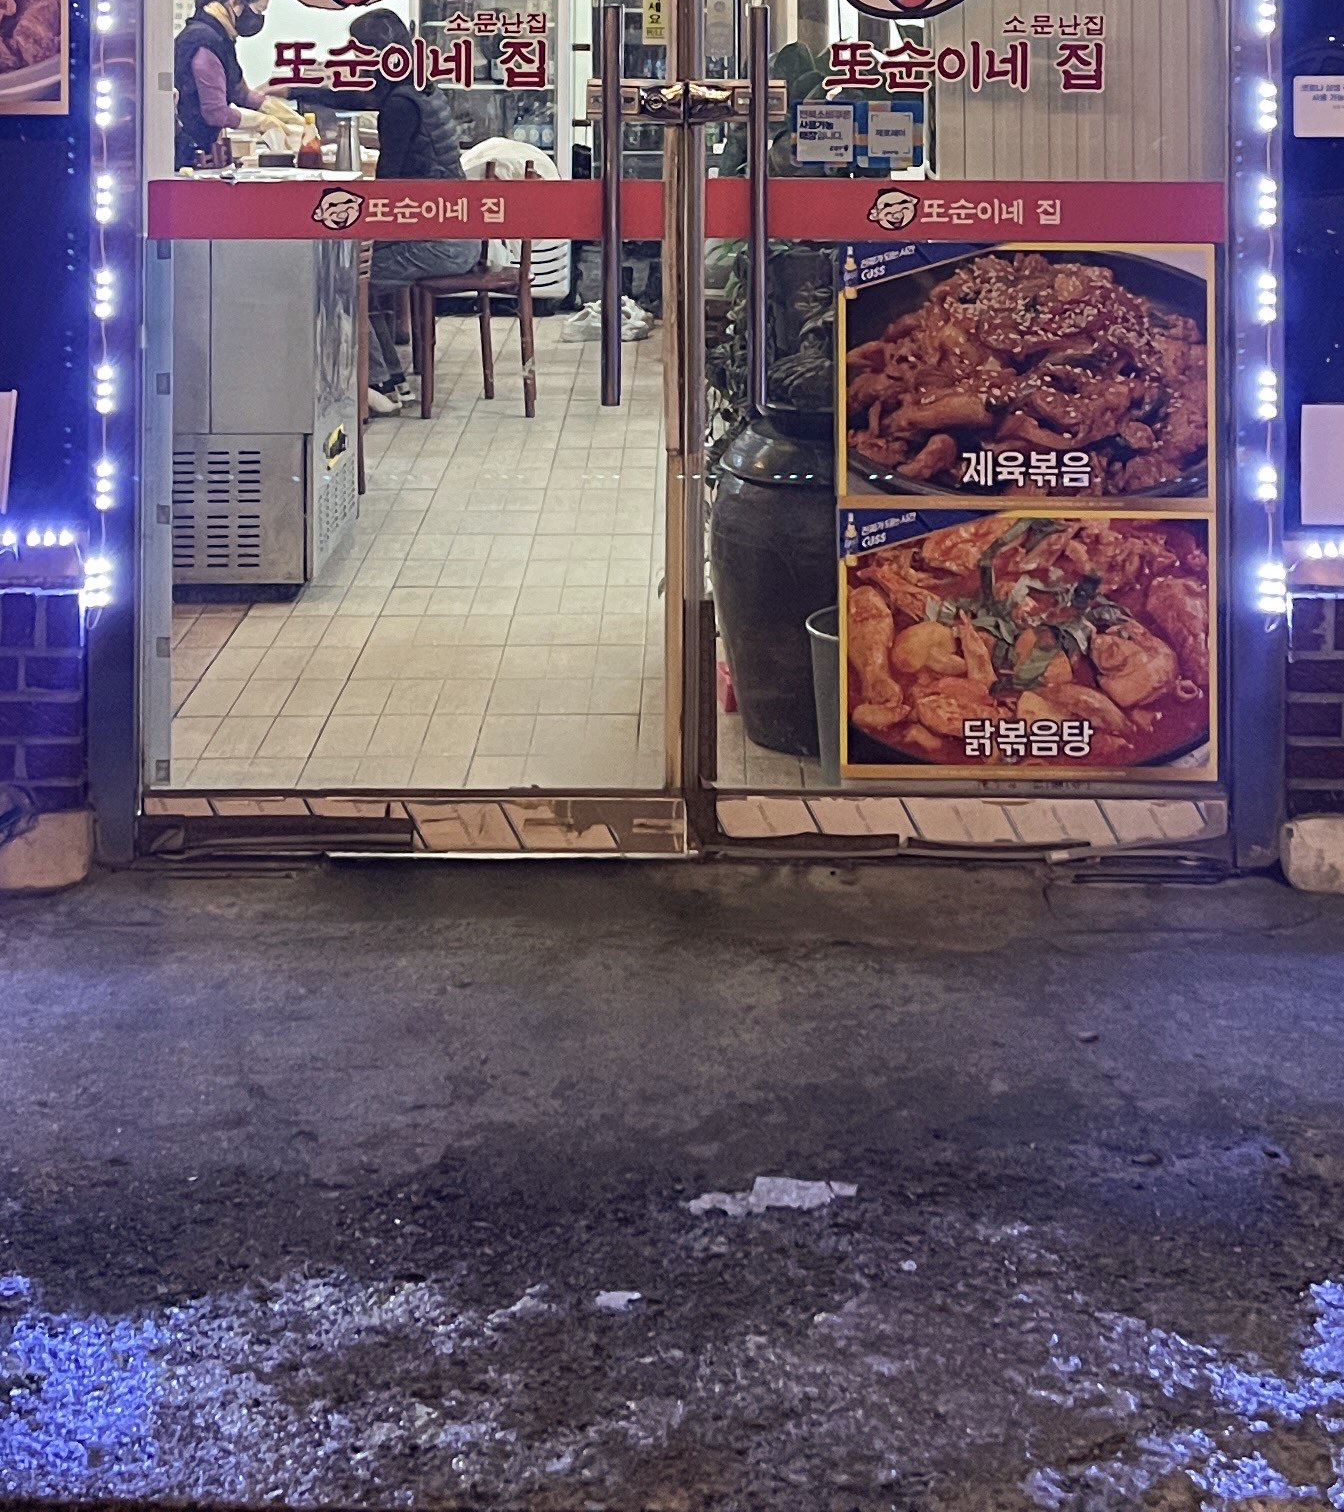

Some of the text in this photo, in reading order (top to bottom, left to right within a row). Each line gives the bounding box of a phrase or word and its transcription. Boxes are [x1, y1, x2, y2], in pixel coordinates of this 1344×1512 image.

[446, 12, 548, 34] 소문난집
[1002, 14, 1105, 36] 소문난집
[268, 39, 548, 90] 또순이네 집
[822, 40, 1104, 92] 또순이네 집
[365, 196, 505, 225] 또순이네 집
[921, 197, 1060, 226] 또순이네 집
[961, 451, 1092, 488] 제육볶음
[963, 720, 1093, 757] 닭볶음탕
